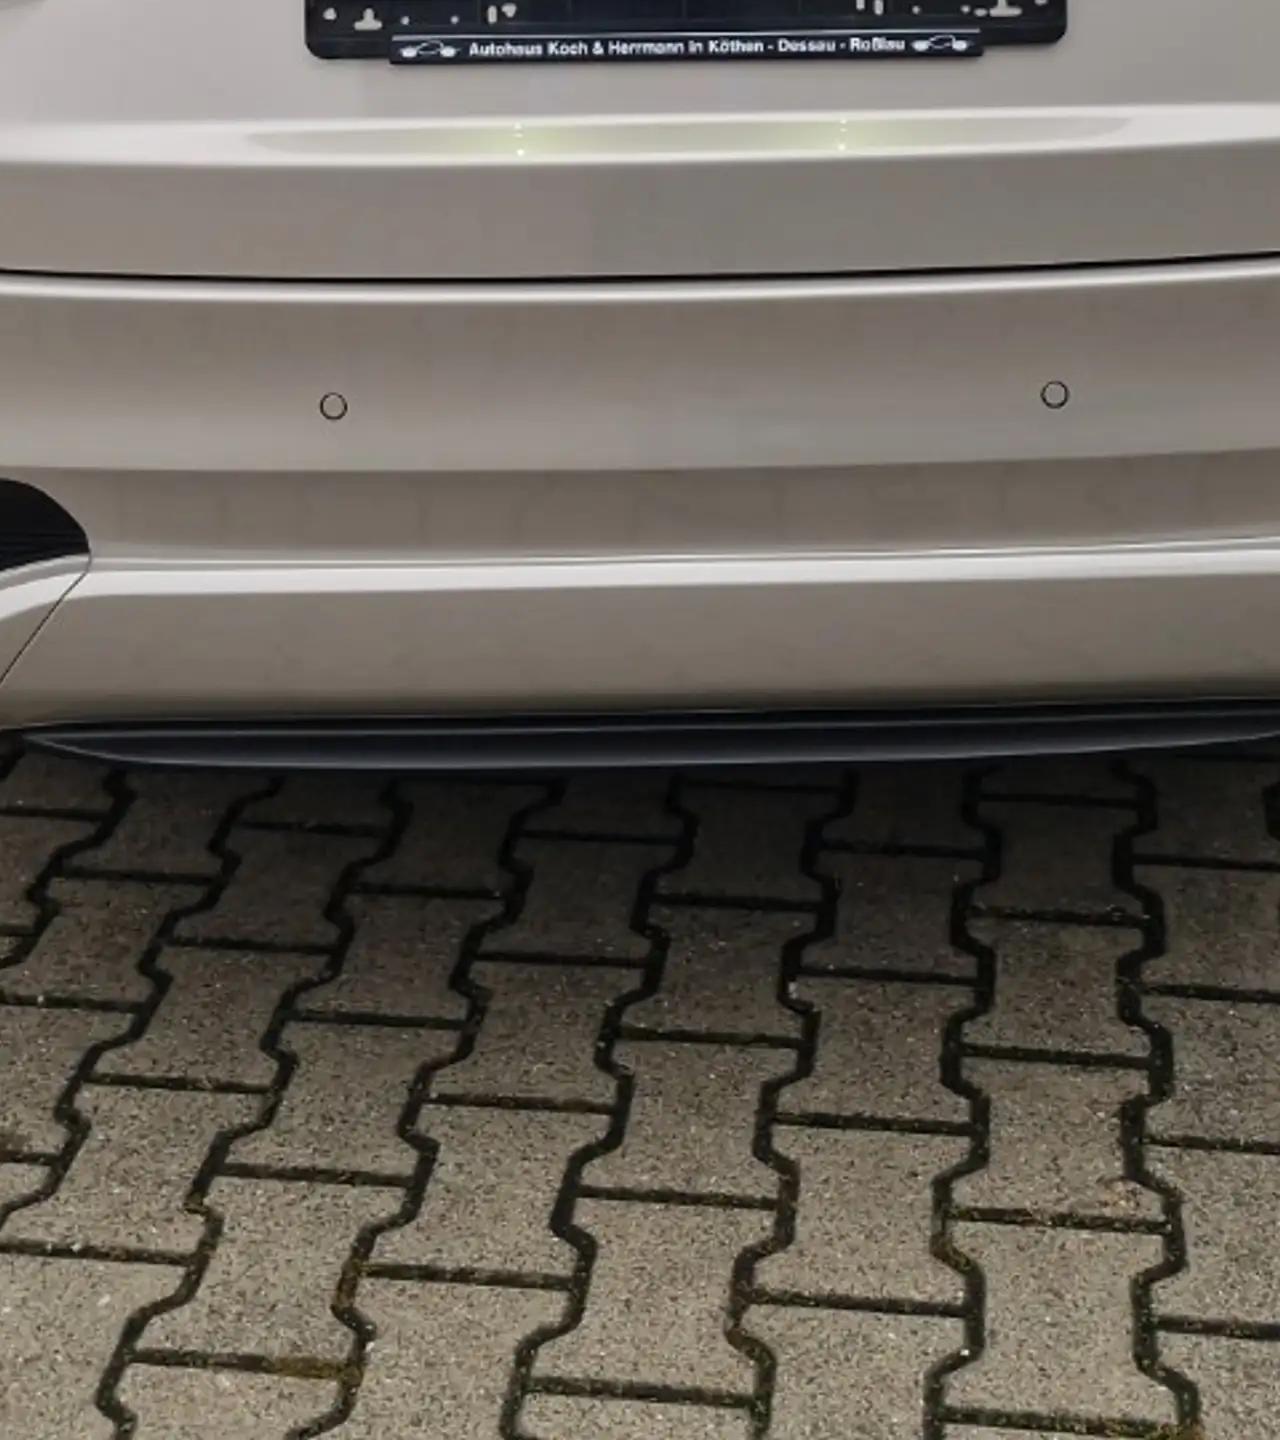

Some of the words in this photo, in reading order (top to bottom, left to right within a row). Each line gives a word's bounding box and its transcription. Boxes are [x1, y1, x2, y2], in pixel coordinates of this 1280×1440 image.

[469, 41, 543, 58] Autohaus
[547, 40, 588, 56] Koch
[591, 41, 605, 56] &
[607, 39, 684, 56] Herrmann
[707, 38, 764, 54] Köthen
[777, 37, 837, 54] Dessau
